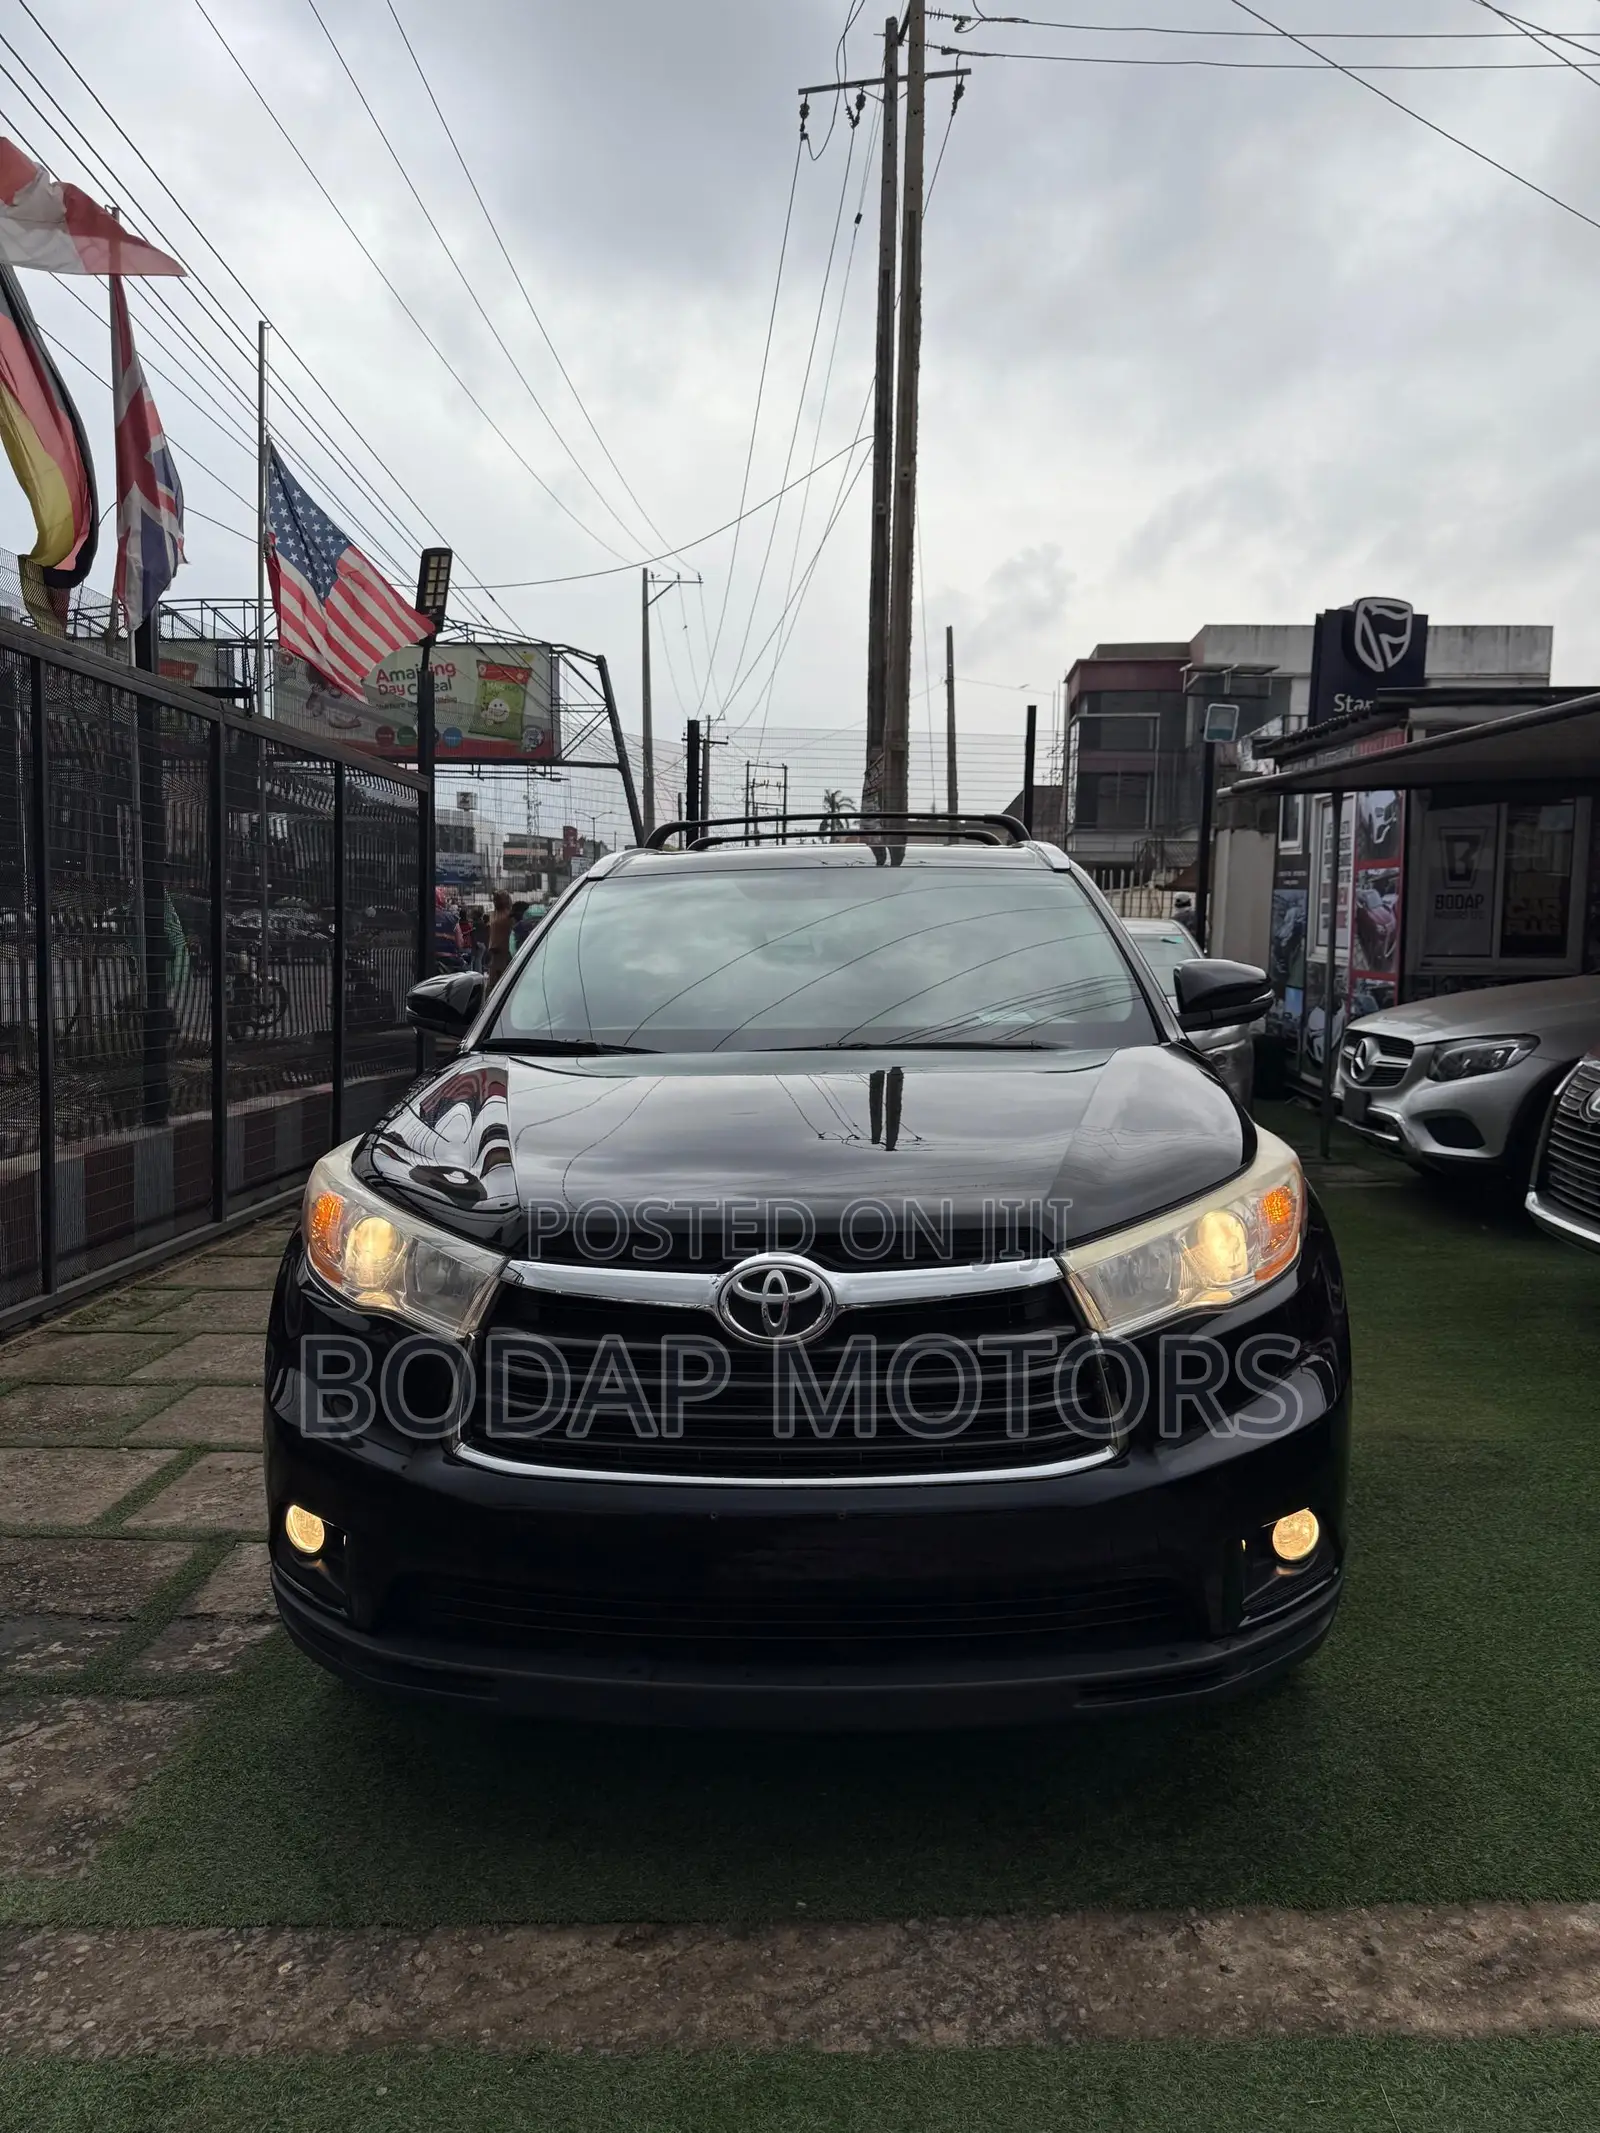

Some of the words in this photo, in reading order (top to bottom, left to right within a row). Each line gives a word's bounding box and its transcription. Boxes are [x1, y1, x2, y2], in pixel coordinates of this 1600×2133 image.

[376, 662, 457, 685] Amaiing
[378, 684, 405, 696] Day
[407, 677, 452, 696] Ceal
[1434, 893, 1485, 910] BODAP
